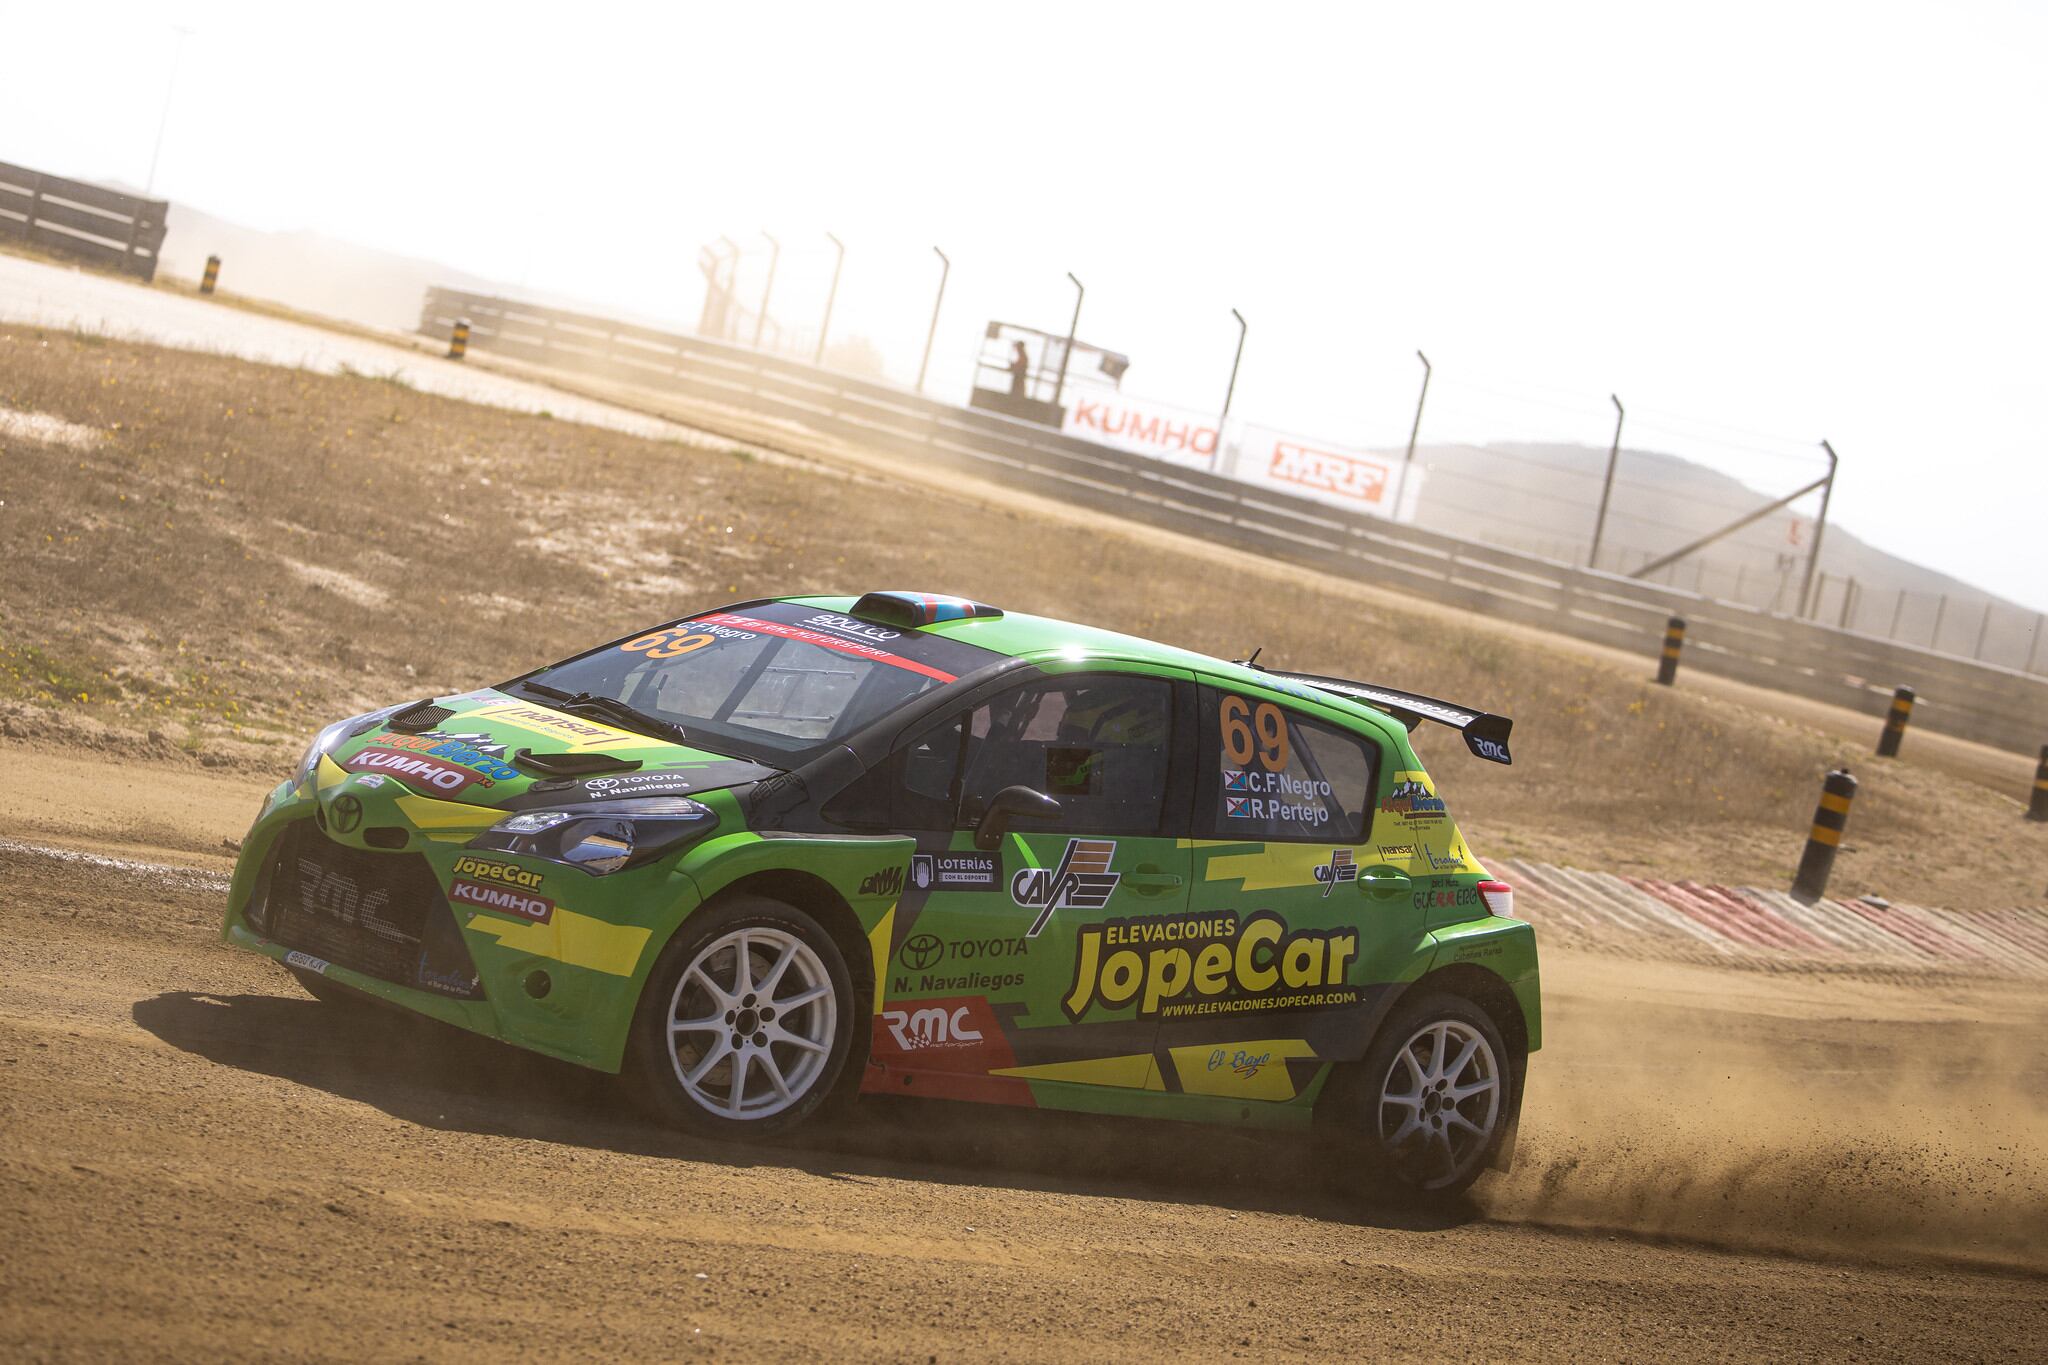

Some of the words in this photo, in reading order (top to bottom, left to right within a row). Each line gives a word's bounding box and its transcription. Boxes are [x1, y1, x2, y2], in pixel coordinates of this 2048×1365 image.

[1074, 399, 1221, 456] KUMHO
[1273, 443, 1387, 501] MRF
[811, 614, 901, 639] sparco
[620, 628, 715, 659] 69
[798, 631, 895, 659] MOTORSPORT
[1220, 695, 1289, 772] 69
[350, 751, 465, 789] KUMHO
[622, 773, 684, 785] TOYOTA
[590, 790, 607, 799] N.
[610, 781, 690, 796] Navaliegos
[1249, 772, 1331, 800] C.F.Negro
[1252, 799, 1329, 827] R.Pertejo
[453, 857, 543, 888] JopeCar
[937, 856, 993, 870] LOTERÍAS
[454, 884, 546, 917] KUMHO
[1106, 918, 1236, 945] ELEVACIONES
[948, 937, 1028, 959] TOYOTA
[1066, 918, 1356, 1016] JopeCar
[894, 976, 913, 993] N.
[920, 972, 1025, 991] Navaliegos
[1162, 991, 1357, 1017] WWW.ELEVACIONESJOPECAR.COM
